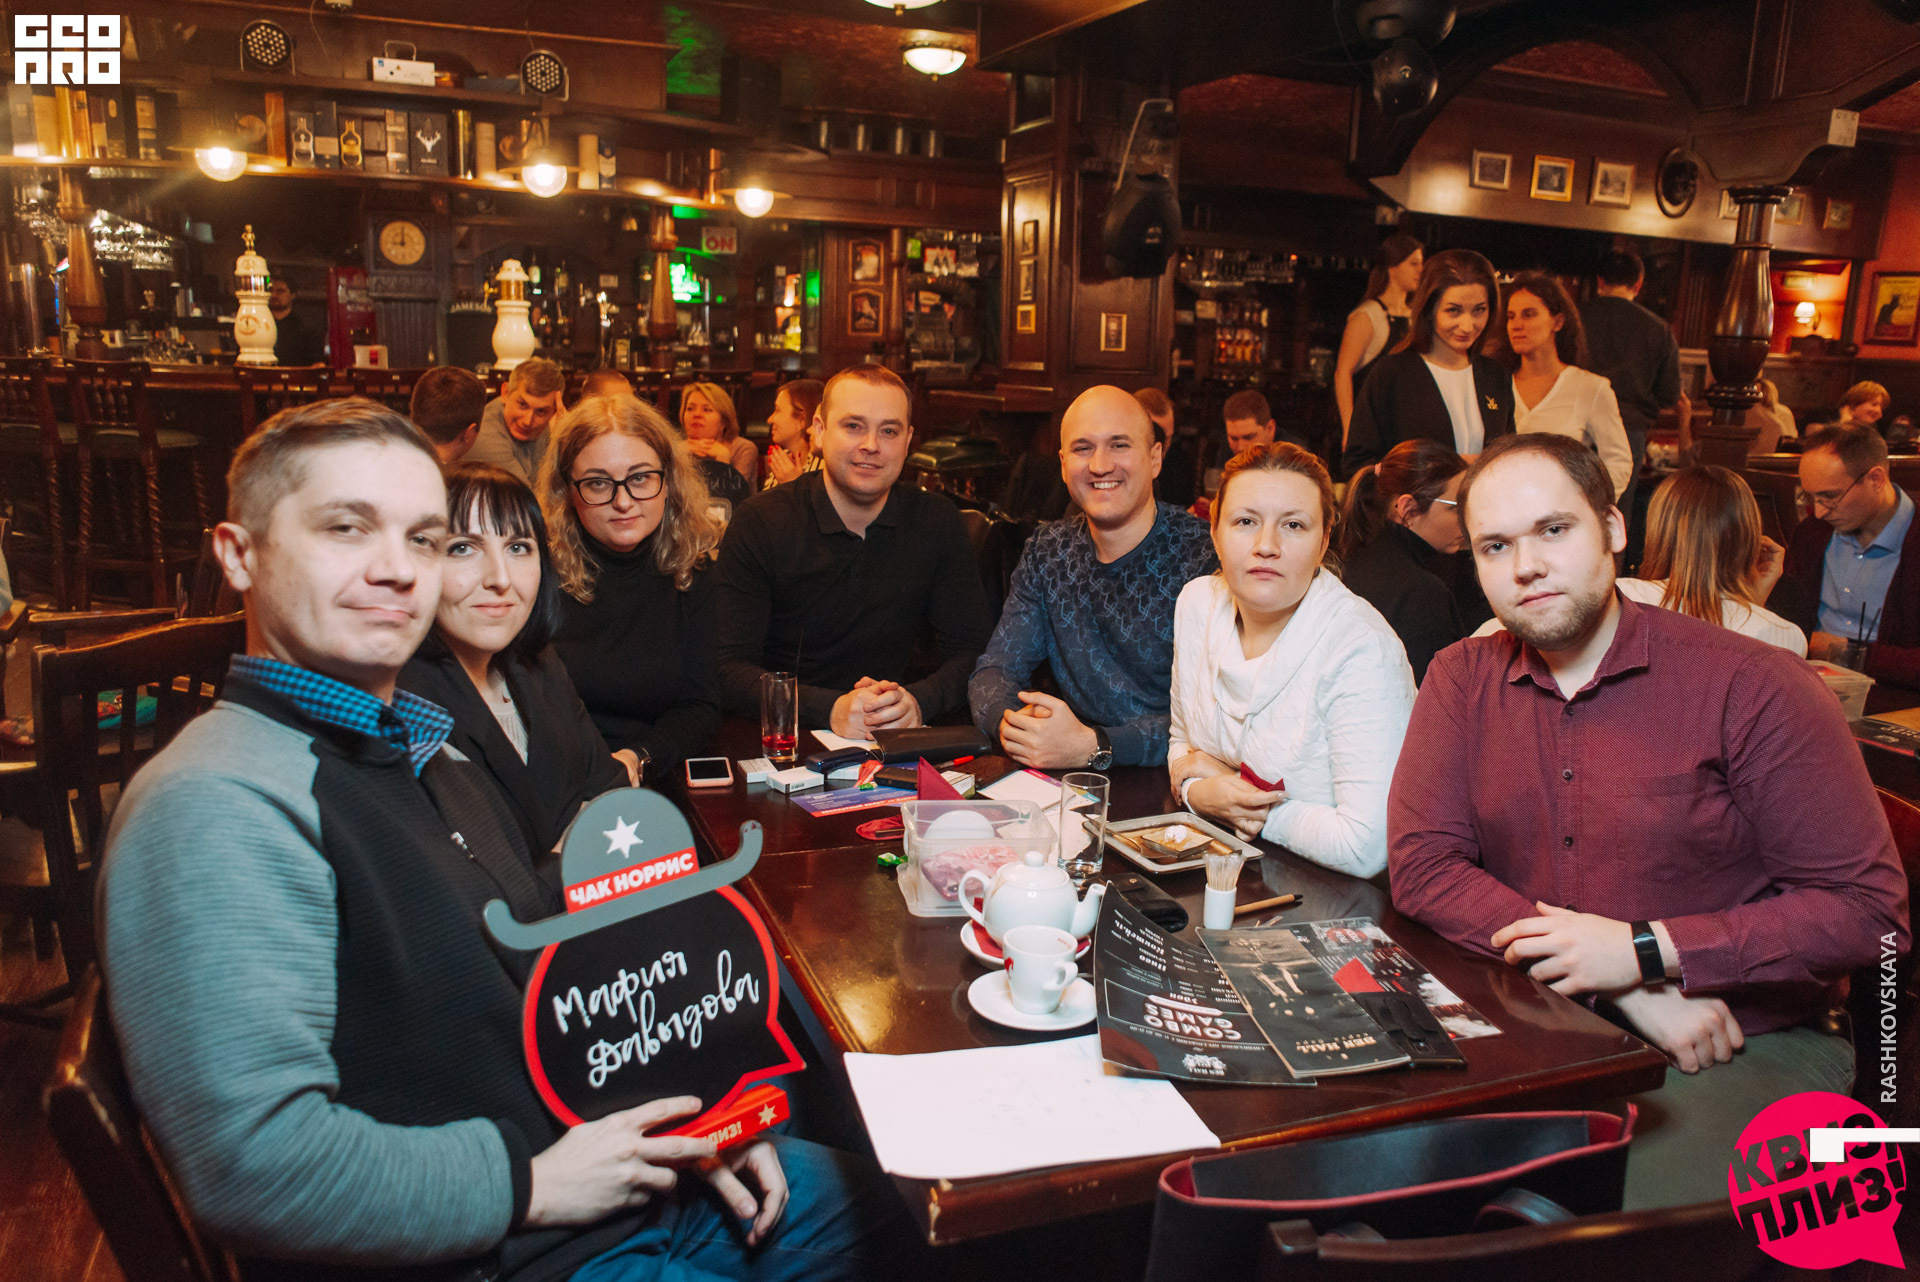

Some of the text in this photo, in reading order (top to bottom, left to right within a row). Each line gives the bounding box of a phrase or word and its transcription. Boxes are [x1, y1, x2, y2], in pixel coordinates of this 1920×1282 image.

[569, 853, 694, 905] ЧАК НОРРИС
[552, 951, 688, 1034] Мафия
[1143, 1014, 1242, 1041] COMBO
[1144, 1002, 1233, 1029] GAMES
[1296, 1036, 1377, 1054] BEN HALL
